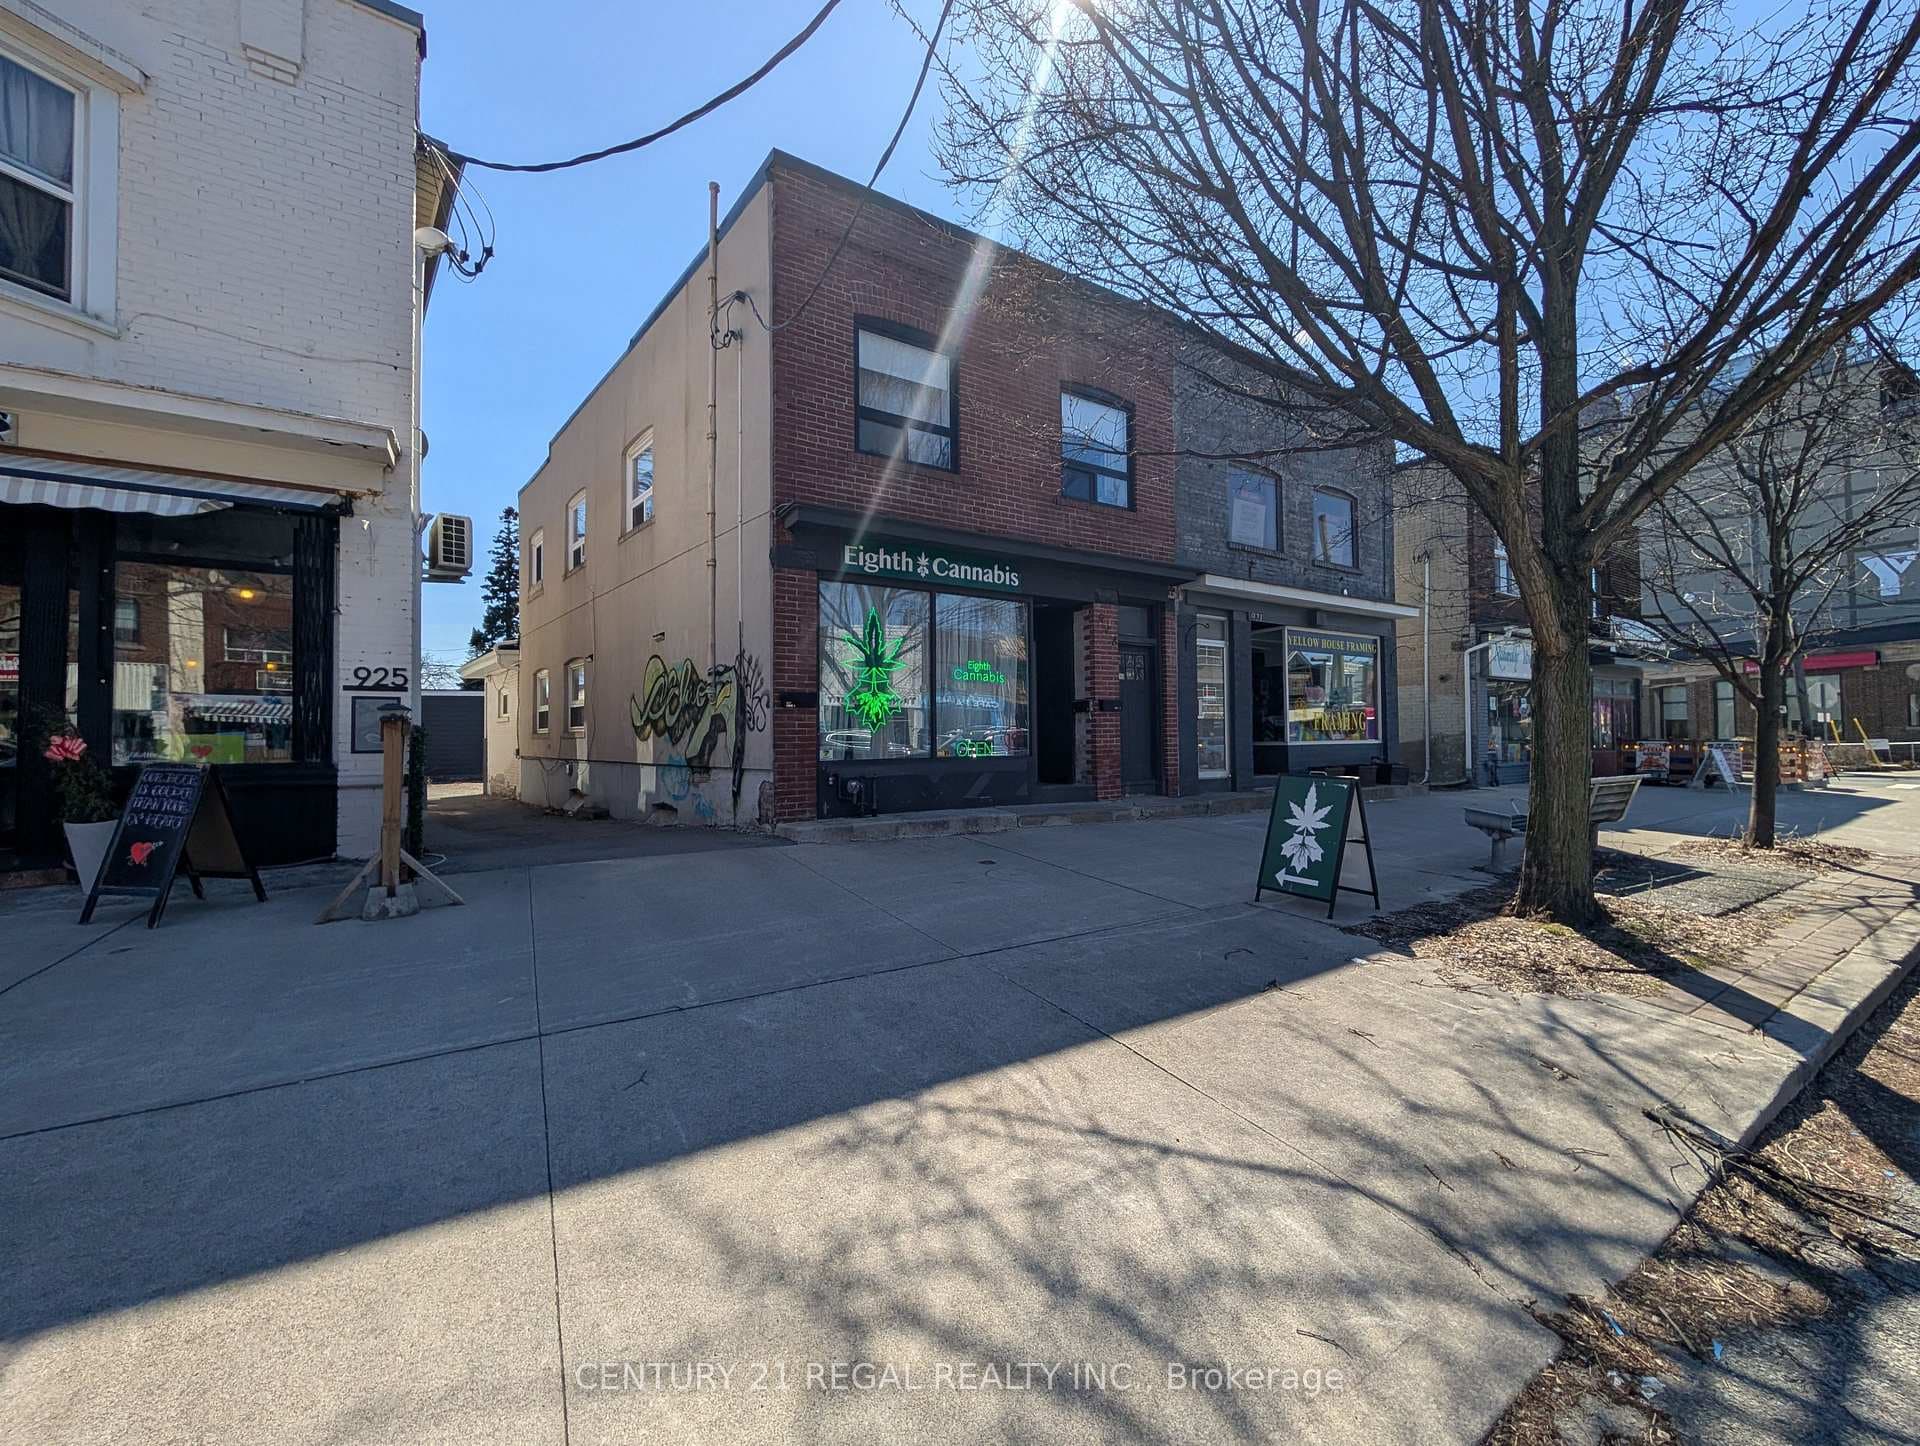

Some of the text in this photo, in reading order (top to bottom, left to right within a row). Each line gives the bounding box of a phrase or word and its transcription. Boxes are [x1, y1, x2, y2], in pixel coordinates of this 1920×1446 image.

[844, 545, 1019, 587] Eighth Cannabis
[1288, 635, 1377, 654] YELLOW HOUSE FRAMING
[953, 668, 1006, 684] Cannabis
[967, 660, 991, 673] Eighth
[353, 666, 408, 687] 925
[1313, 711, 1366, 731] FRAMING
[956, 741, 993, 757] OPEN
